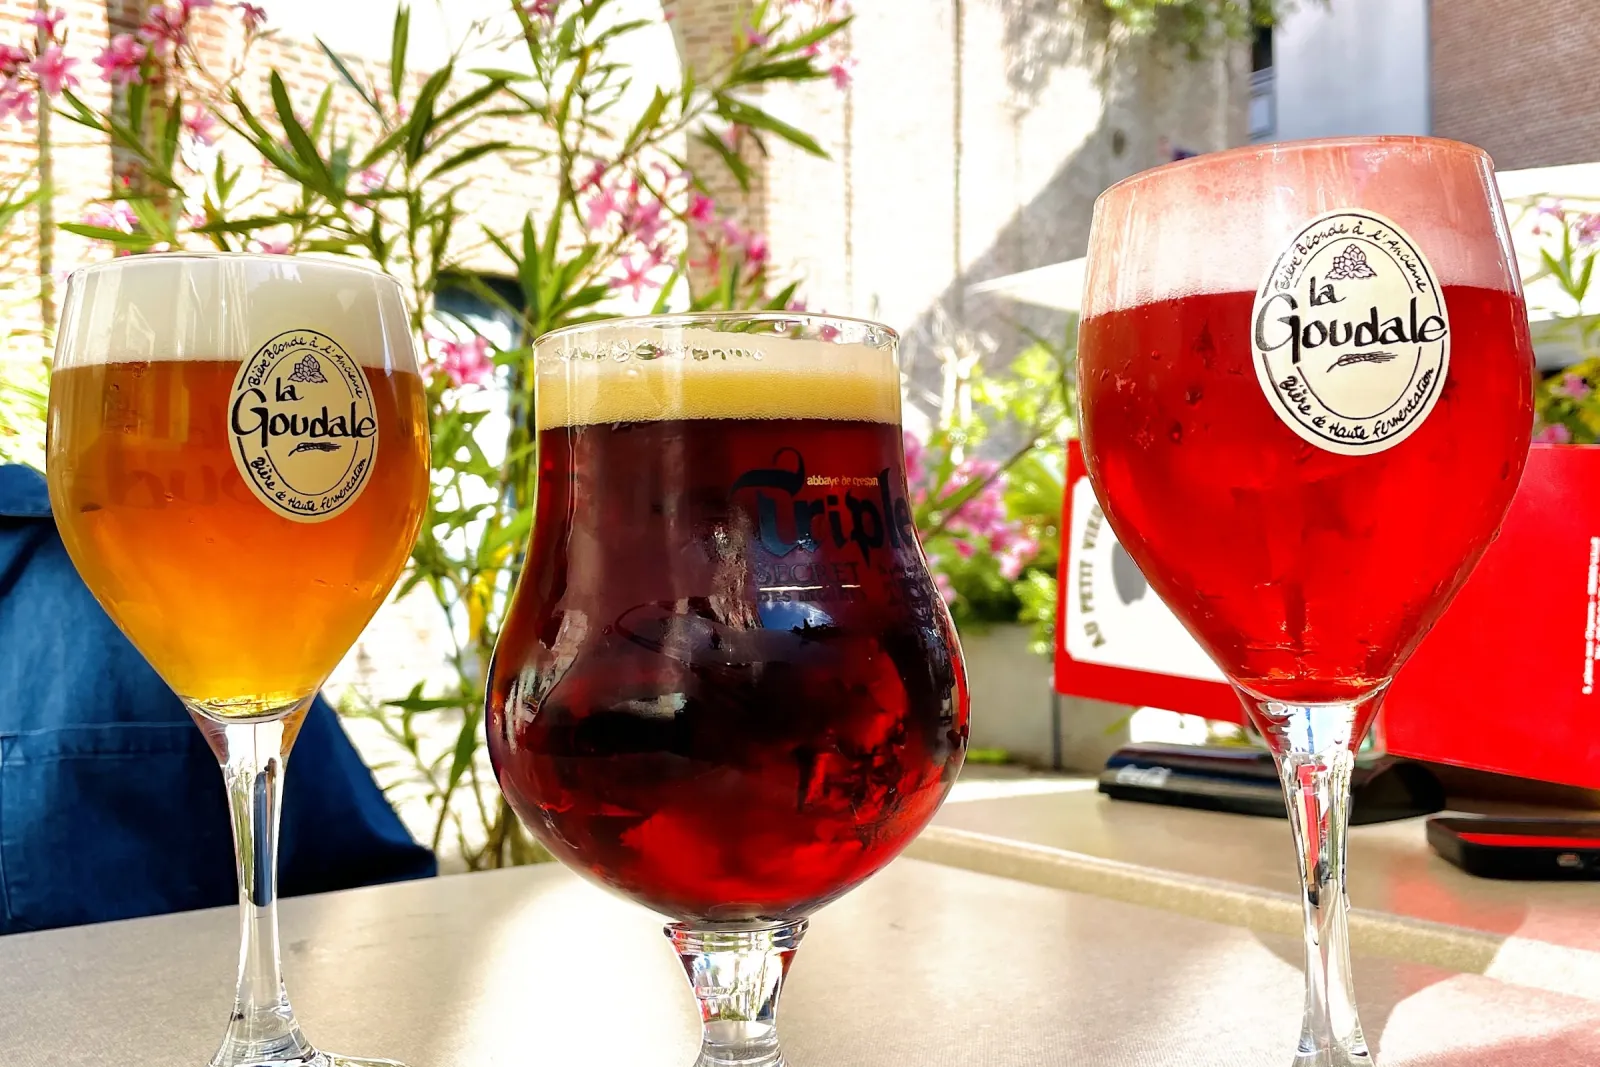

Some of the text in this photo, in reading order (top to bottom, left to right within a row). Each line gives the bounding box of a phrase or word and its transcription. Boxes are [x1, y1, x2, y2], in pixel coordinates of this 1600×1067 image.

[1296, 223, 1349, 255] Blonde
[1310, 276, 1346, 306] la
[1255, 293, 1447, 365] Goudale
[248, 357, 270, 386] Bière
[264, 337, 306, 360] Blonde
[275, 377, 304, 402] la
[1280, 376, 1311, 416] Bière
[1312, 416, 1326, 429] de
[1328, 424, 1369, 440] Haute
[231, 388, 376, 448] Goudale
[251, 457, 274, 490] Bière
[275, 491, 286, 501] de
[288, 498, 318, 511] Haute
[807, 475, 840, 490] abbaye
[727, 447, 917, 568] Triple
[757, 562, 860, 584] SECRET
[1079, 560, 1094, 614] PETIT
[1083, 621, 1107, 648] AU
